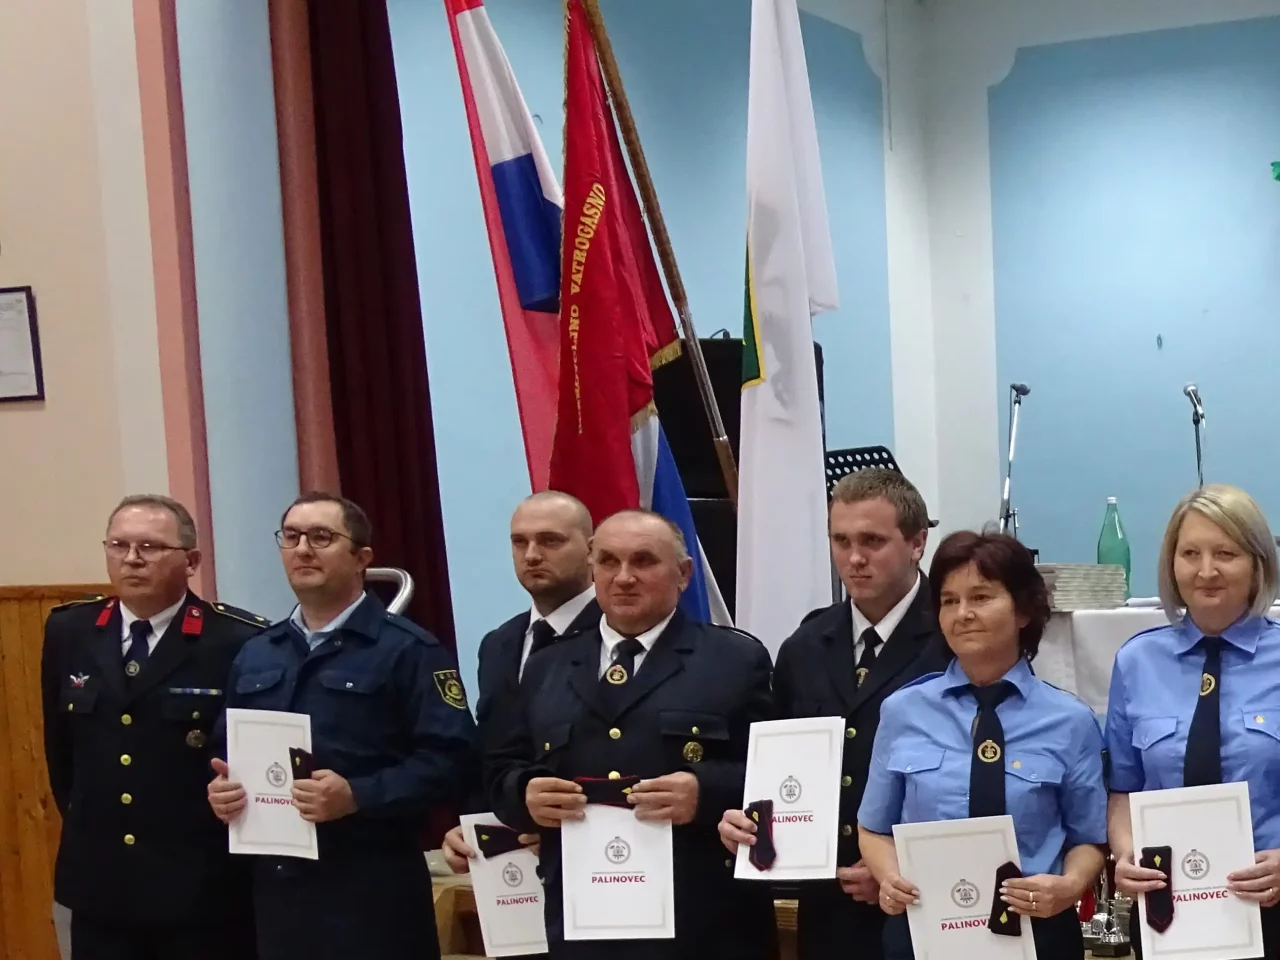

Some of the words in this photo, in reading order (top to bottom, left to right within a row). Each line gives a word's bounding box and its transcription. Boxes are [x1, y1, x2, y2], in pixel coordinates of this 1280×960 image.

[255, 796, 294, 806] PALINOV
[771, 814, 814, 824] ALINOVEC
[591, 874, 646, 884] PALINOVEC
[496, 895, 540, 906] PALINOVEC
[940, 917, 989, 931] PALINOV
